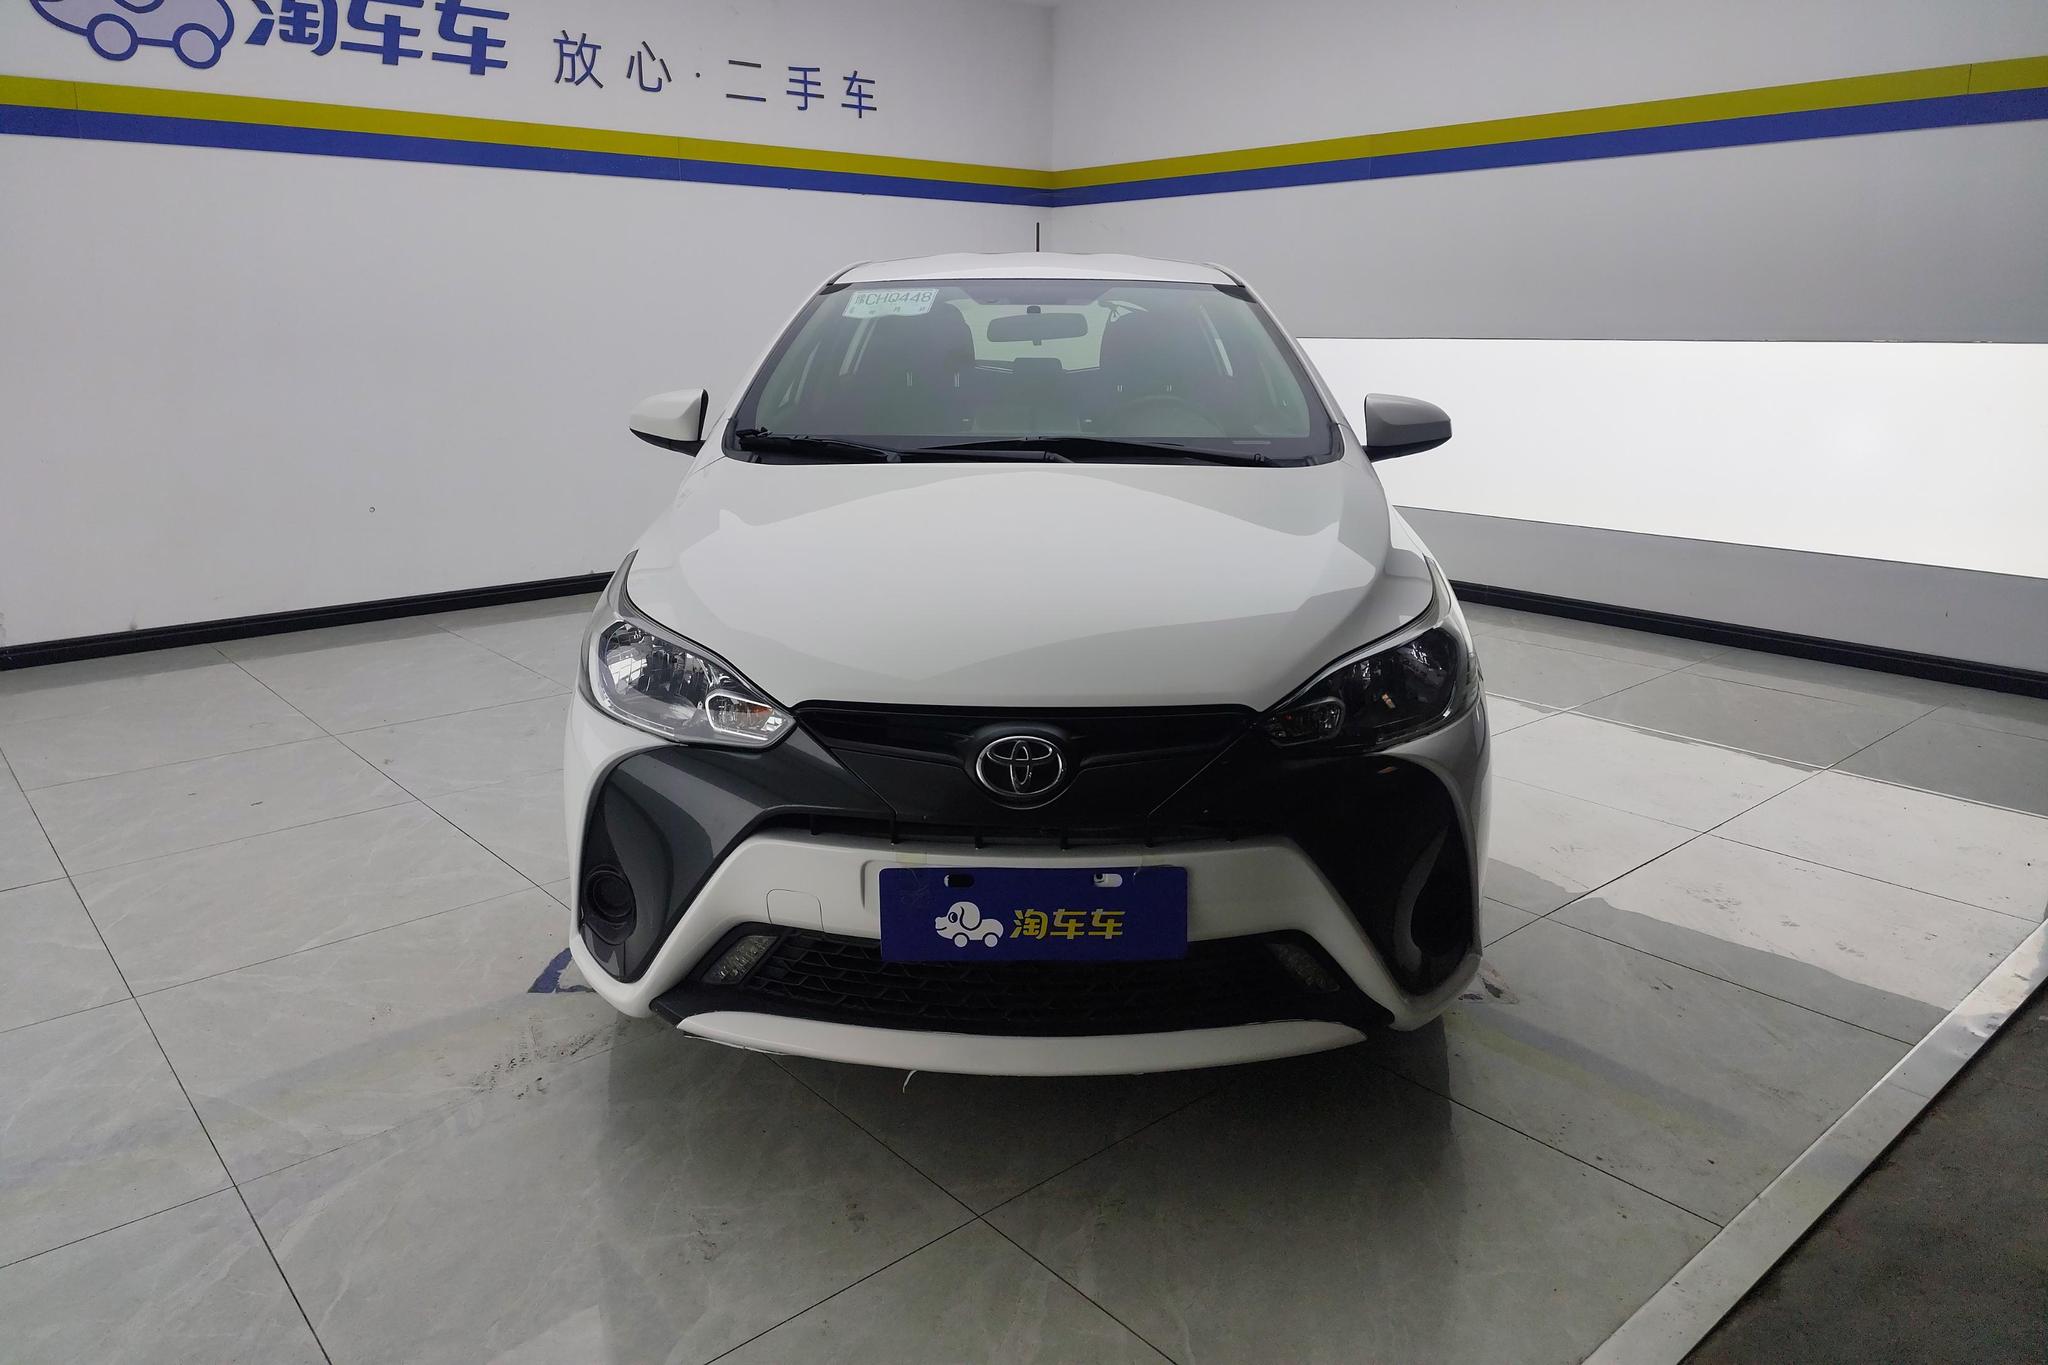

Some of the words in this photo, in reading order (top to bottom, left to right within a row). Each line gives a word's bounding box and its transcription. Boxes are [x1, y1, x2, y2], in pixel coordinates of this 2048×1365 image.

[245, 0, 509, 75] 淘车车
[1009, 908, 1126, 940] 淘车车
